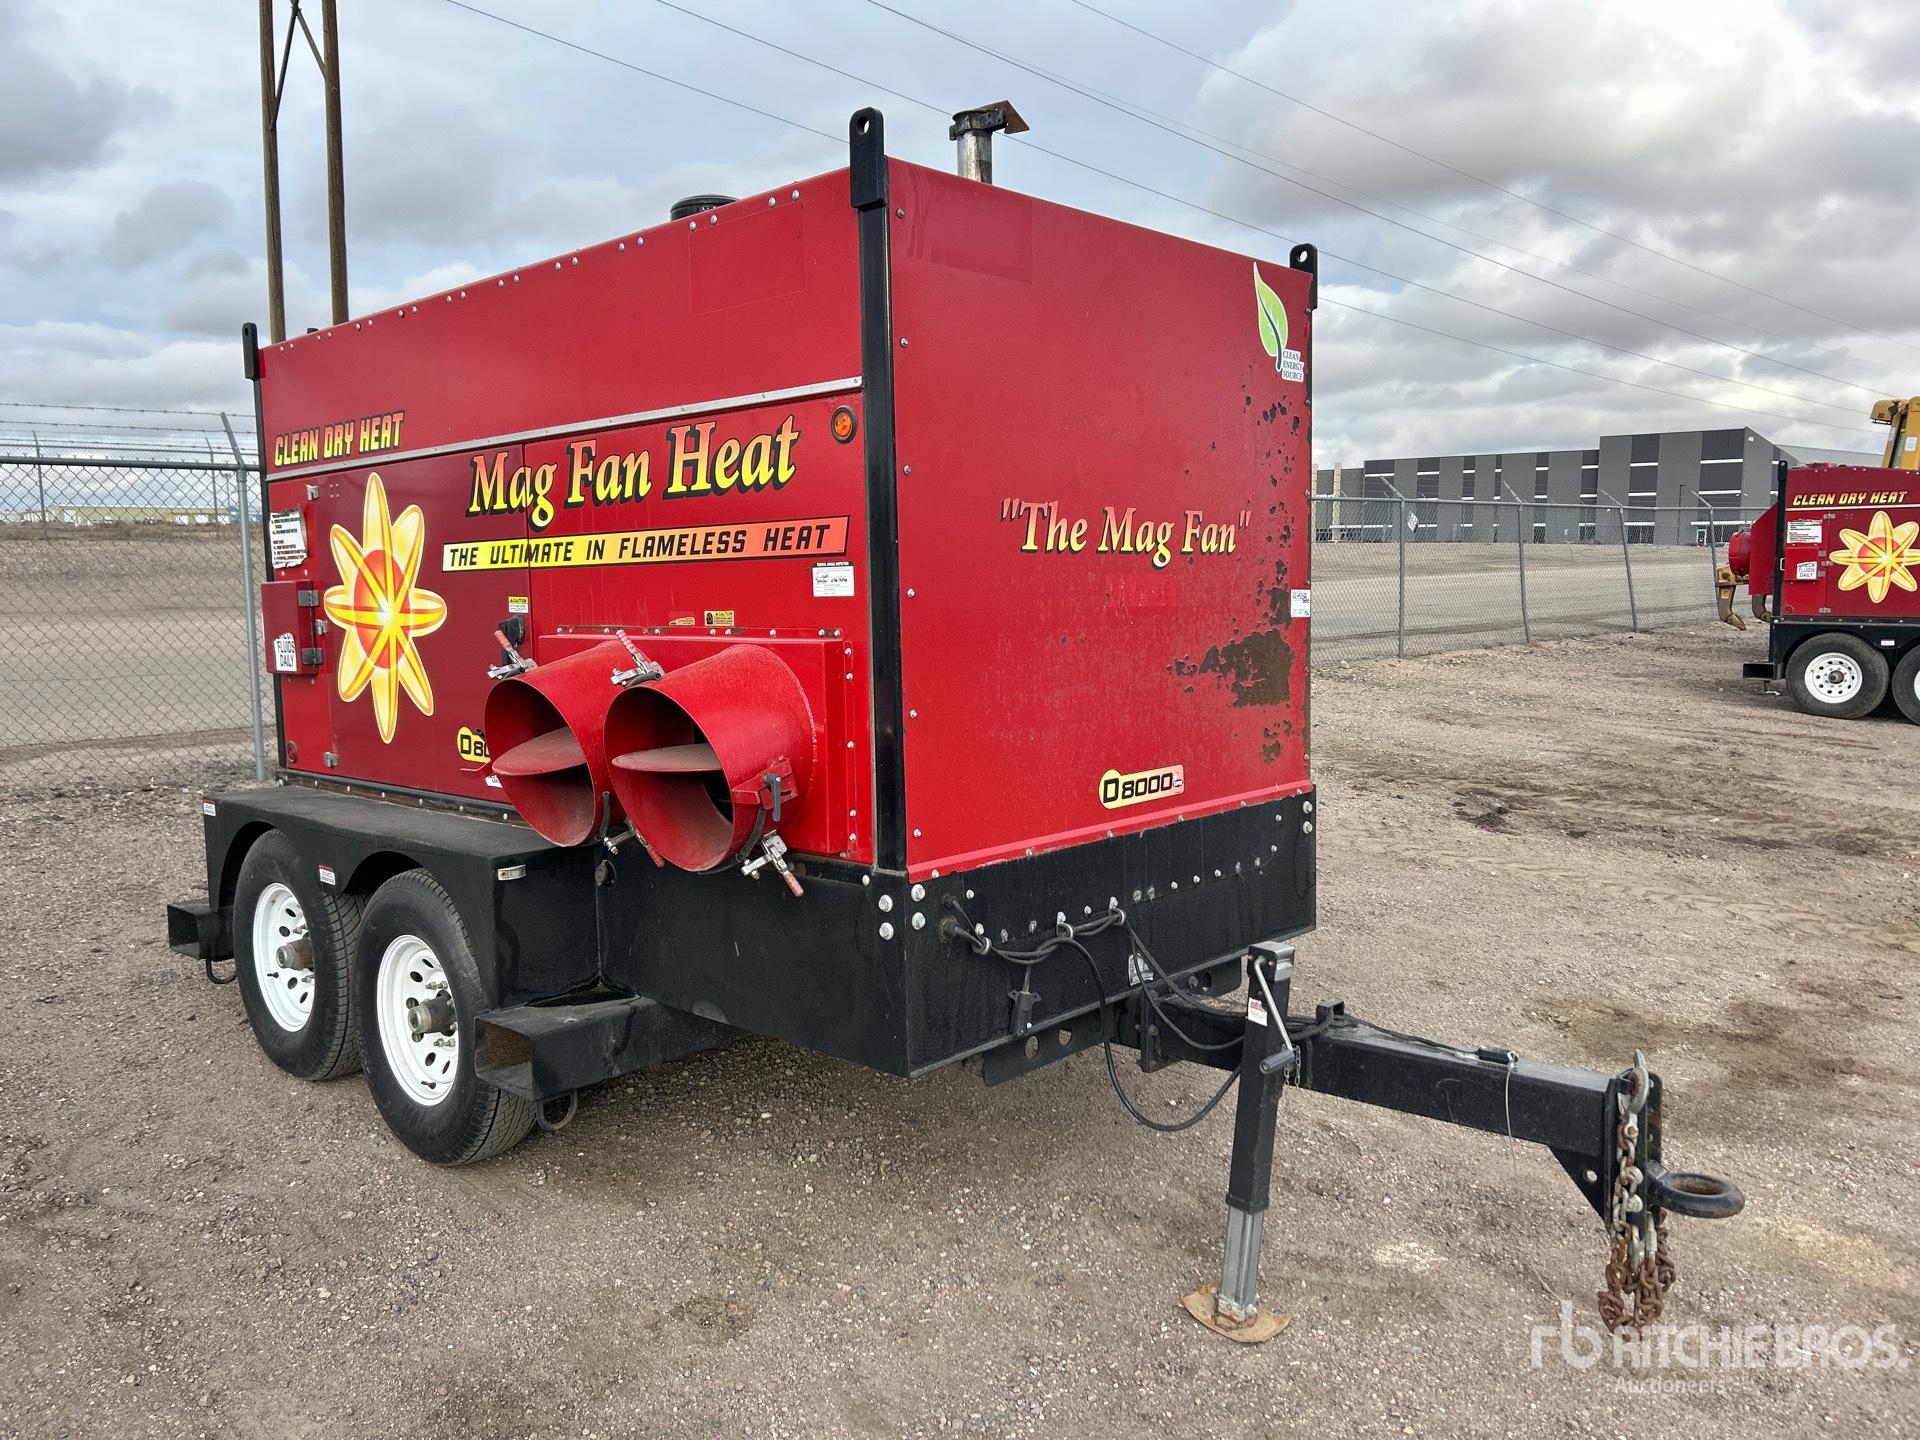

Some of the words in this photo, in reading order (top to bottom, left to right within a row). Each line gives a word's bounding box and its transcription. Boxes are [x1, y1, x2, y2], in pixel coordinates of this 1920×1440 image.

[1282, 351, 1299, 360] CLEAN
[1282, 361, 1303, 370] ENERGY
[1282, 370, 1302, 380] SOURCE
[274, 428, 319, 467] CLEAN
[323, 420, 354, 459] DRY
[359, 411, 404, 453] HEAT
[466, 452, 557, 532] Mag
[564, 439, 652, 508] Fan
[663, 414, 800, 499] Heat
[1793, 494, 1835, 506] CLEAN
[1838, 492, 1867, 504] DRY
[1870, 491, 1908, 503] HEAT
[1096, 506, 1175, 569] Mag
[450, 547, 478, 567] THE
[490, 541, 574, 565] ULTIMATE
[586, 539, 605, 560] IN
[618, 530, 746, 558] FLAMELESS
[763, 524, 830, 551] HEAT
[276, 640, 294, 652] FLUIDS
[280, 654, 294, 666] DAILY
